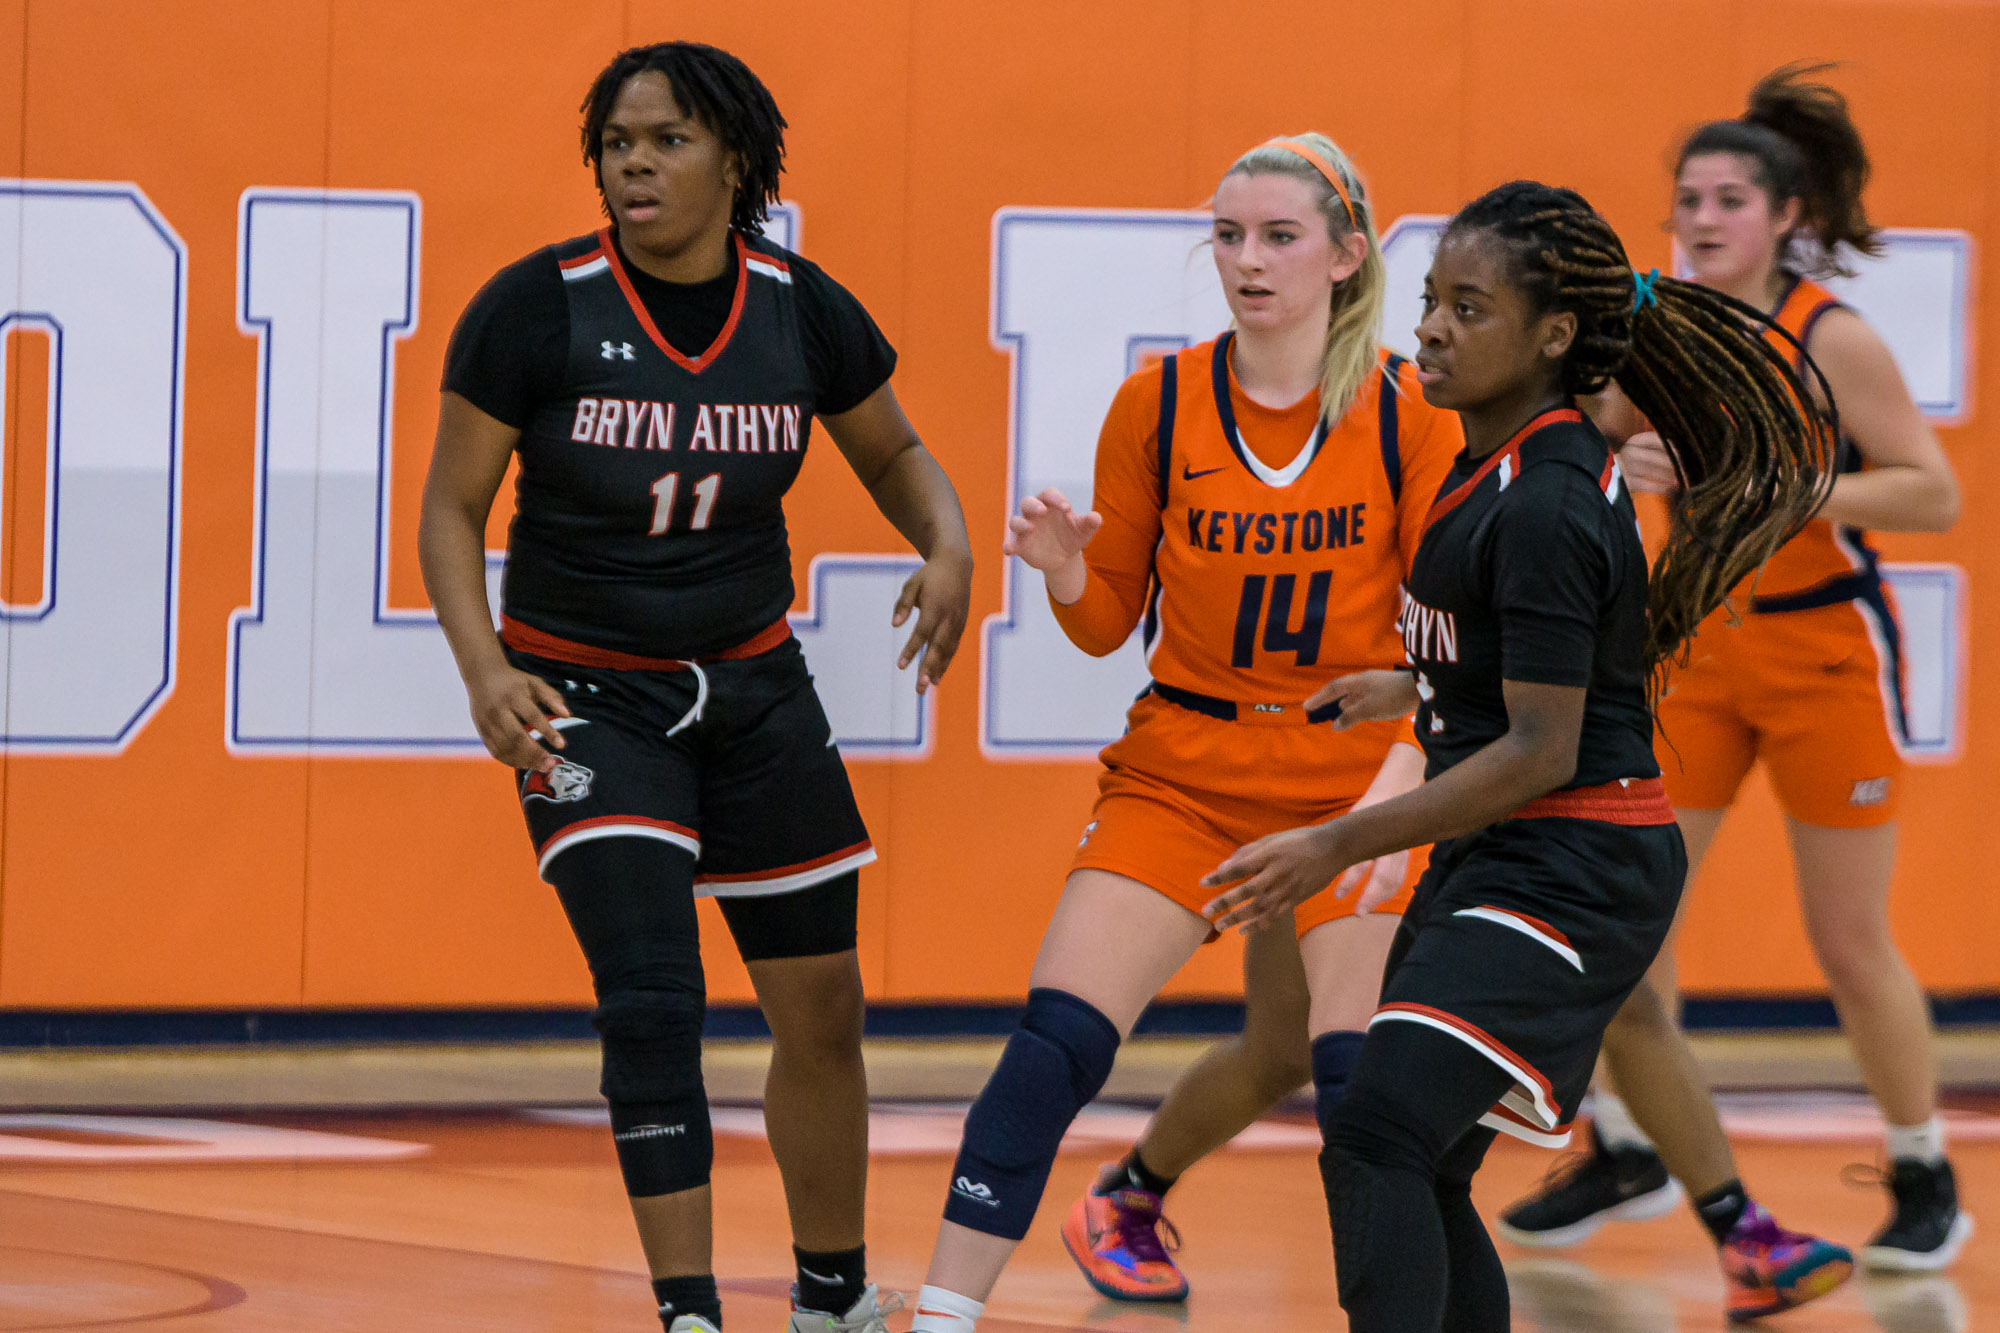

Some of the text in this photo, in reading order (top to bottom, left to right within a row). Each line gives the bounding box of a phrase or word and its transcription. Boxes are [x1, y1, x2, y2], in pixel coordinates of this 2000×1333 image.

[571, 397, 800, 452] BRYN ATHYN
[647, 471, 722, 536] 11
[1187, 502, 1367, 555] KEYSTONE
[1231, 570, 1333, 668] 14
